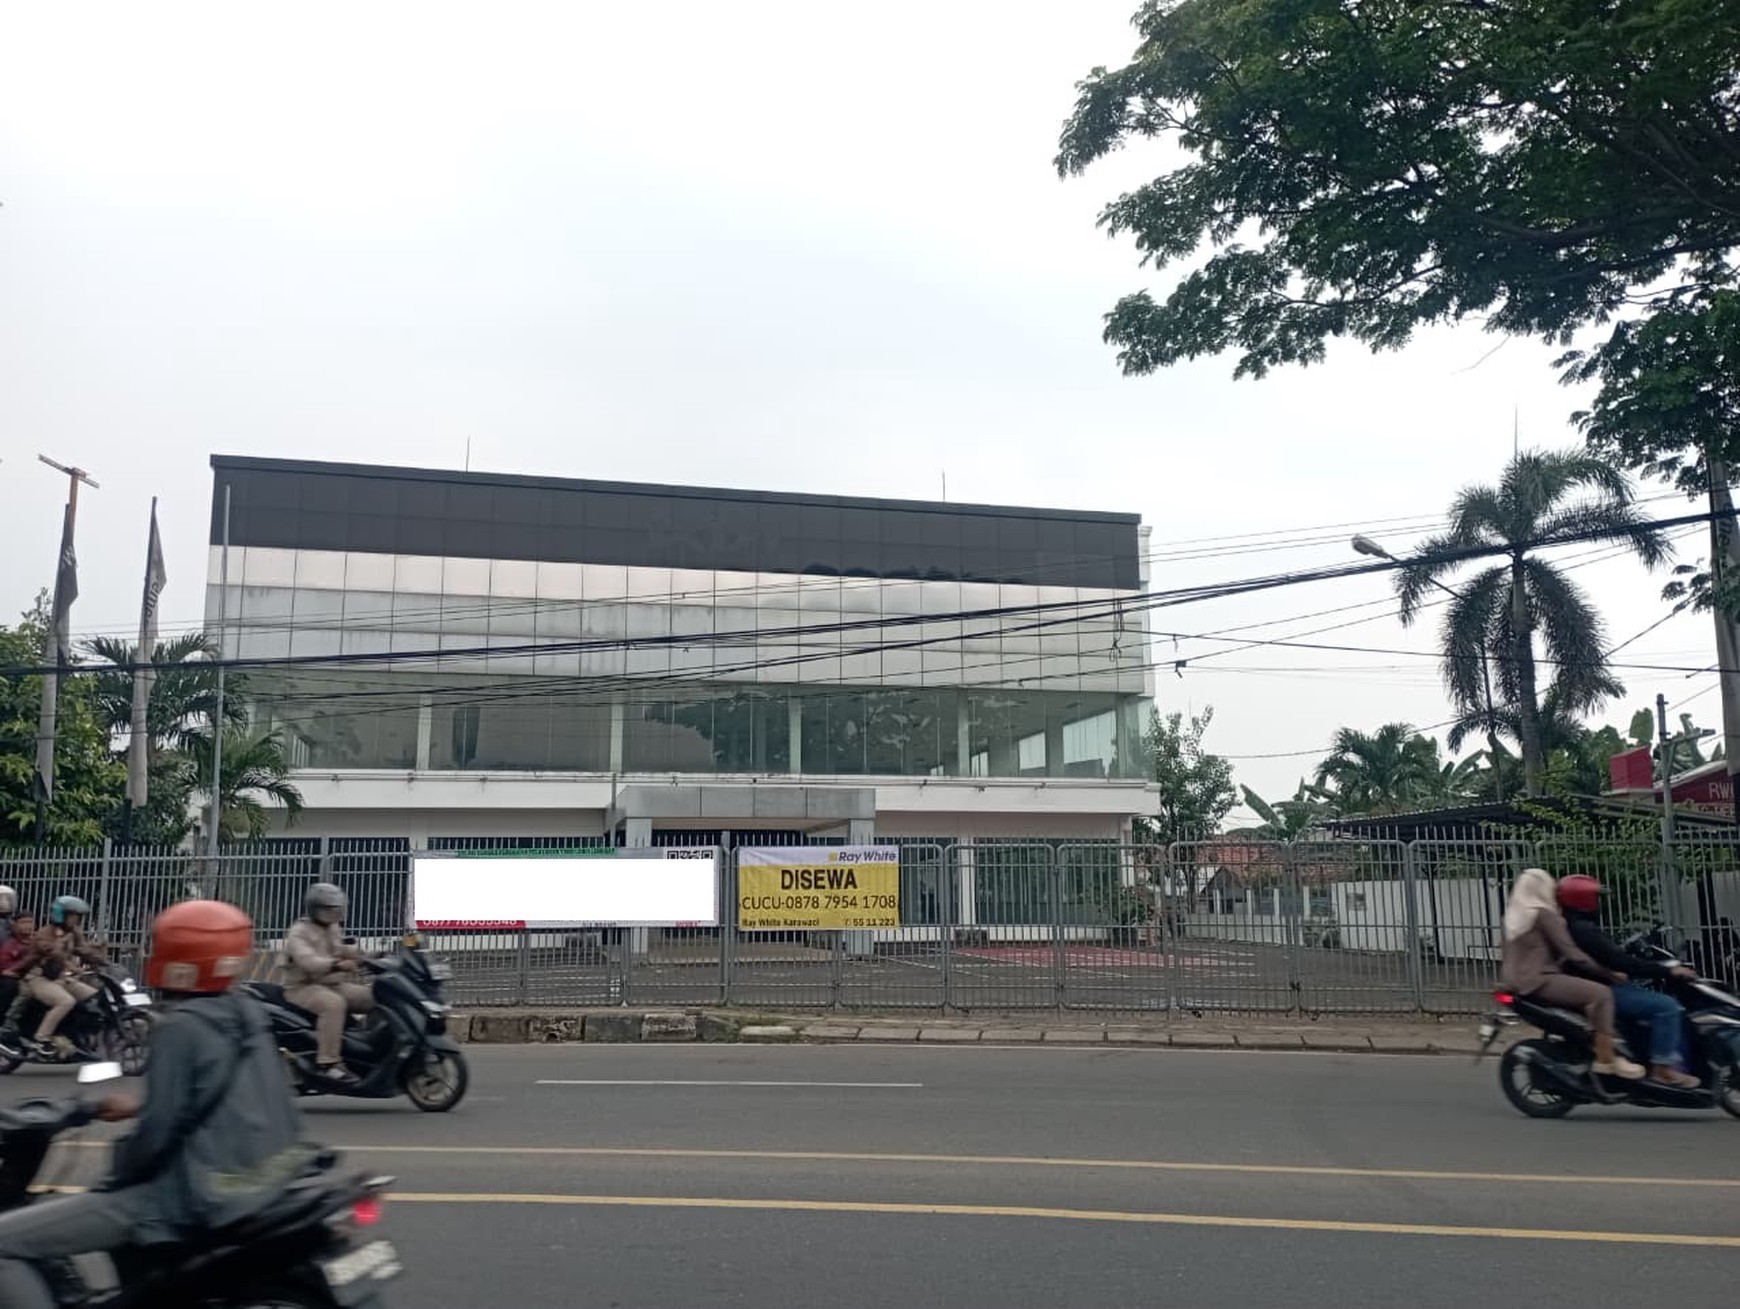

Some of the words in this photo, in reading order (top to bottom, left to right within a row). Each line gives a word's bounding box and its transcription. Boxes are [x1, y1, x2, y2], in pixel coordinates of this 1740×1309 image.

[839, 852, 861, 863] Ray
[863, 850, 896, 862] White
[781, 869, 858, 890] DISEWA
[742, 895, 820, 910] CUCU-0878
[824, 895, 858, 909] 7954
[863, 894, 896, 909] 1708
[742, 918, 756, 928] Ray
[758, 918, 780, 927] White
[784, 918, 819, 927] Karawaci
[853, 918, 863, 927] 55
[879, 918, 895, 927] 223
